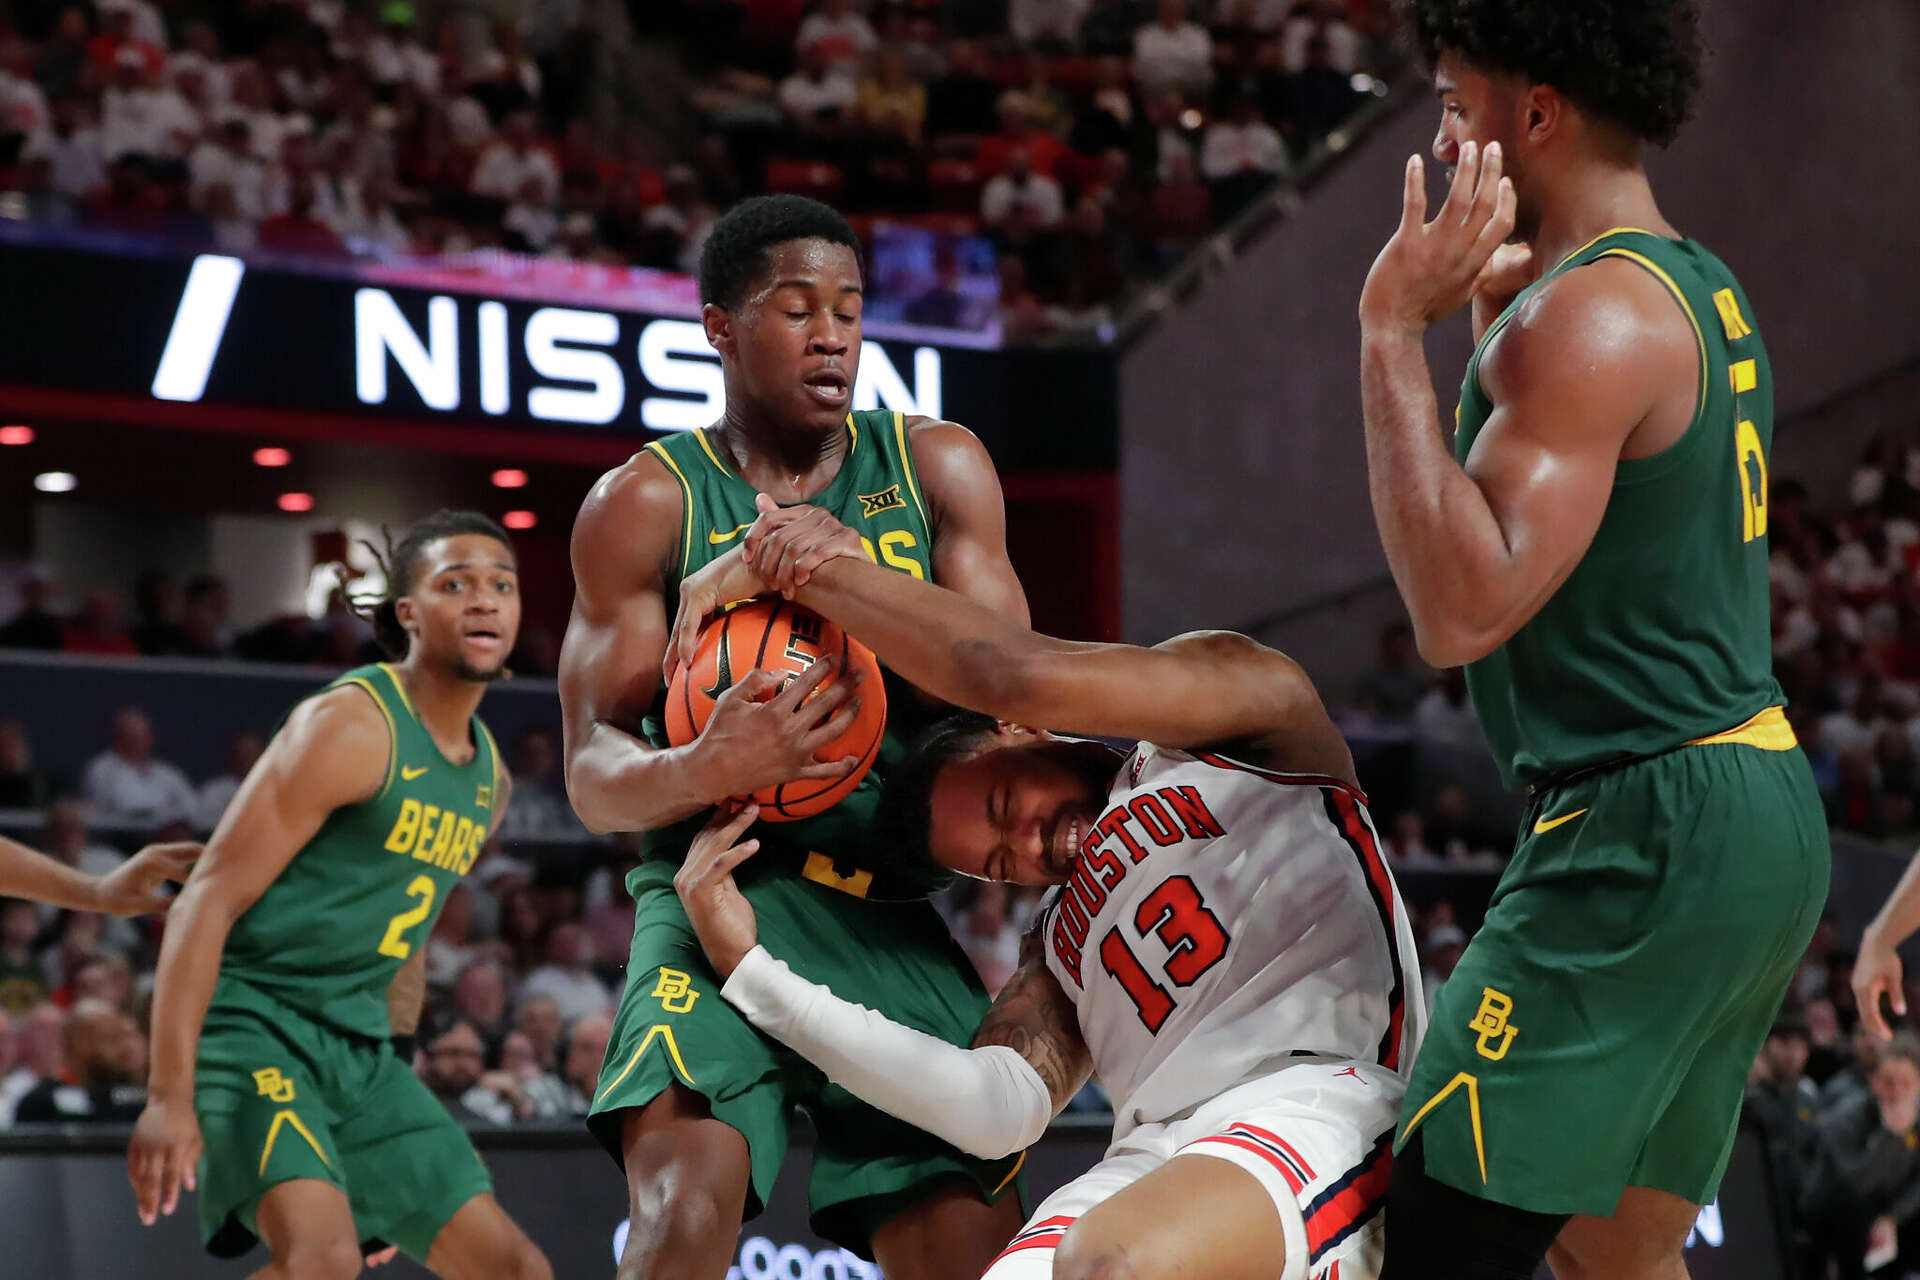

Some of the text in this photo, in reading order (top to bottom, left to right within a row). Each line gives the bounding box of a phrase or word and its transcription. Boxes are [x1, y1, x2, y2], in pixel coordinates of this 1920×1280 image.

[354, 287, 942, 430] NISSN
[384, 797, 487, 876] BEARS
[378, 875, 436, 960] 2
[1052, 785, 1228, 990] HOUSTON
[651, 966, 701, 1014] BU
[1100, 875, 1231, 1037] 13
[1469, 987, 1519, 1061] BU
